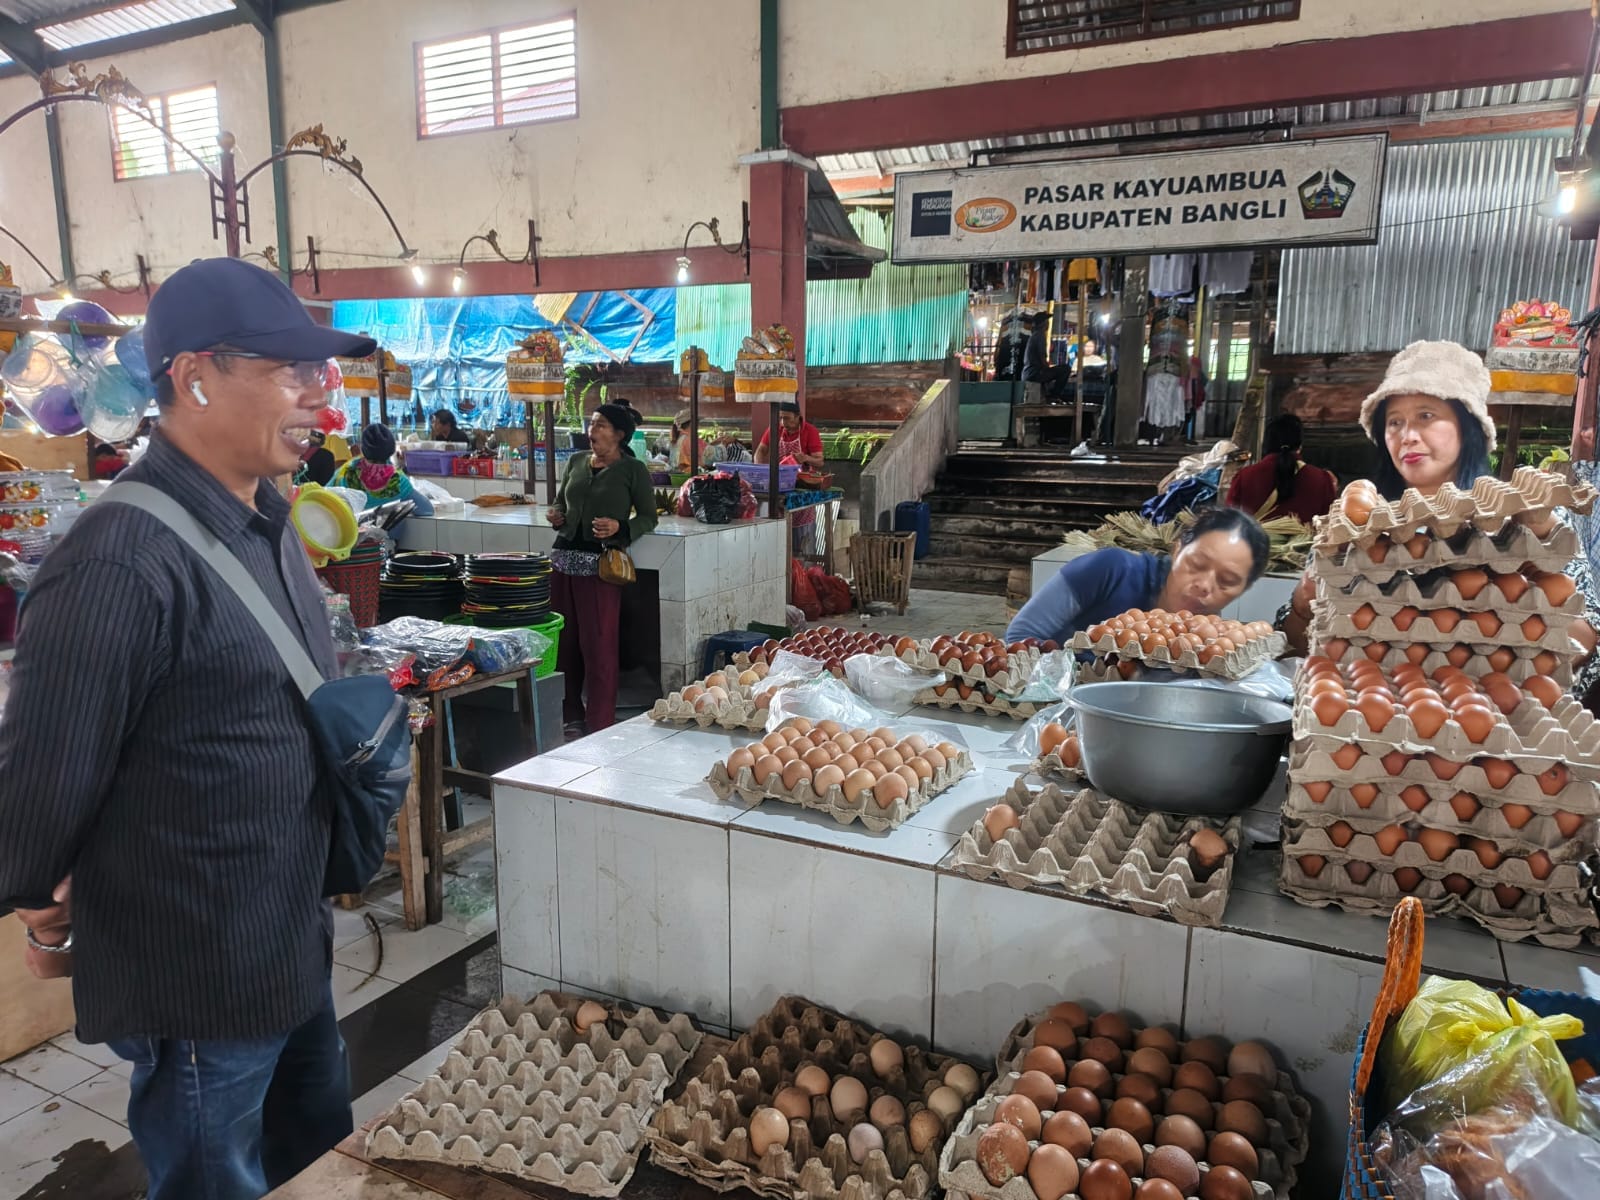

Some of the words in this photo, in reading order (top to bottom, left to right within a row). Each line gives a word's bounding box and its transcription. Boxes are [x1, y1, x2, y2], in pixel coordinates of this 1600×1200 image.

[1025, 183, 1104, 204] PASAR
[1113, 169, 1287, 199] KAYUAMBUA
[1020, 206, 1172, 232] KABUPATEN
[1181, 199, 1287, 224] BANGLI
